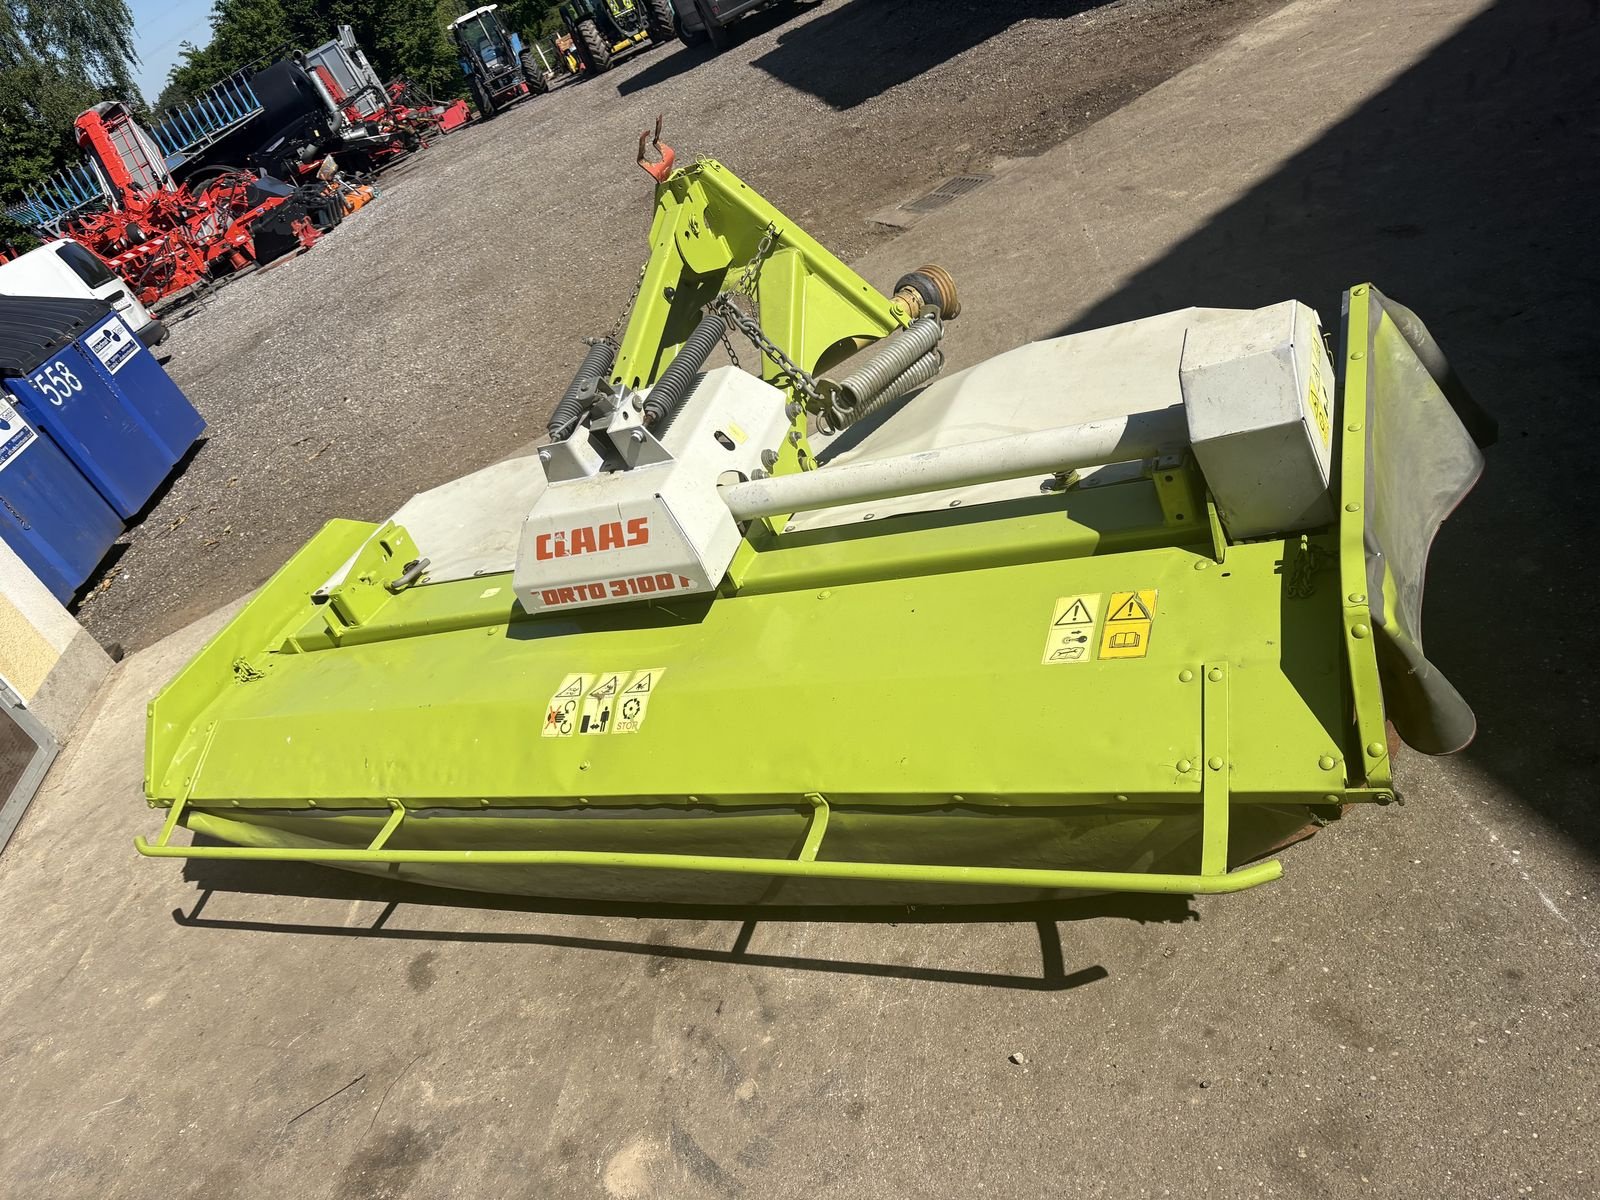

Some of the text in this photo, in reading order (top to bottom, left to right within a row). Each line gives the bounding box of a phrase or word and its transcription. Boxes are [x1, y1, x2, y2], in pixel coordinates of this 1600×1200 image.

[34, 361, 83, 406] 558
[536, 516, 649, 561] CLAAS
[530, 582, 608, 606] ORTO
[608, 573, 676, 597] 3100
